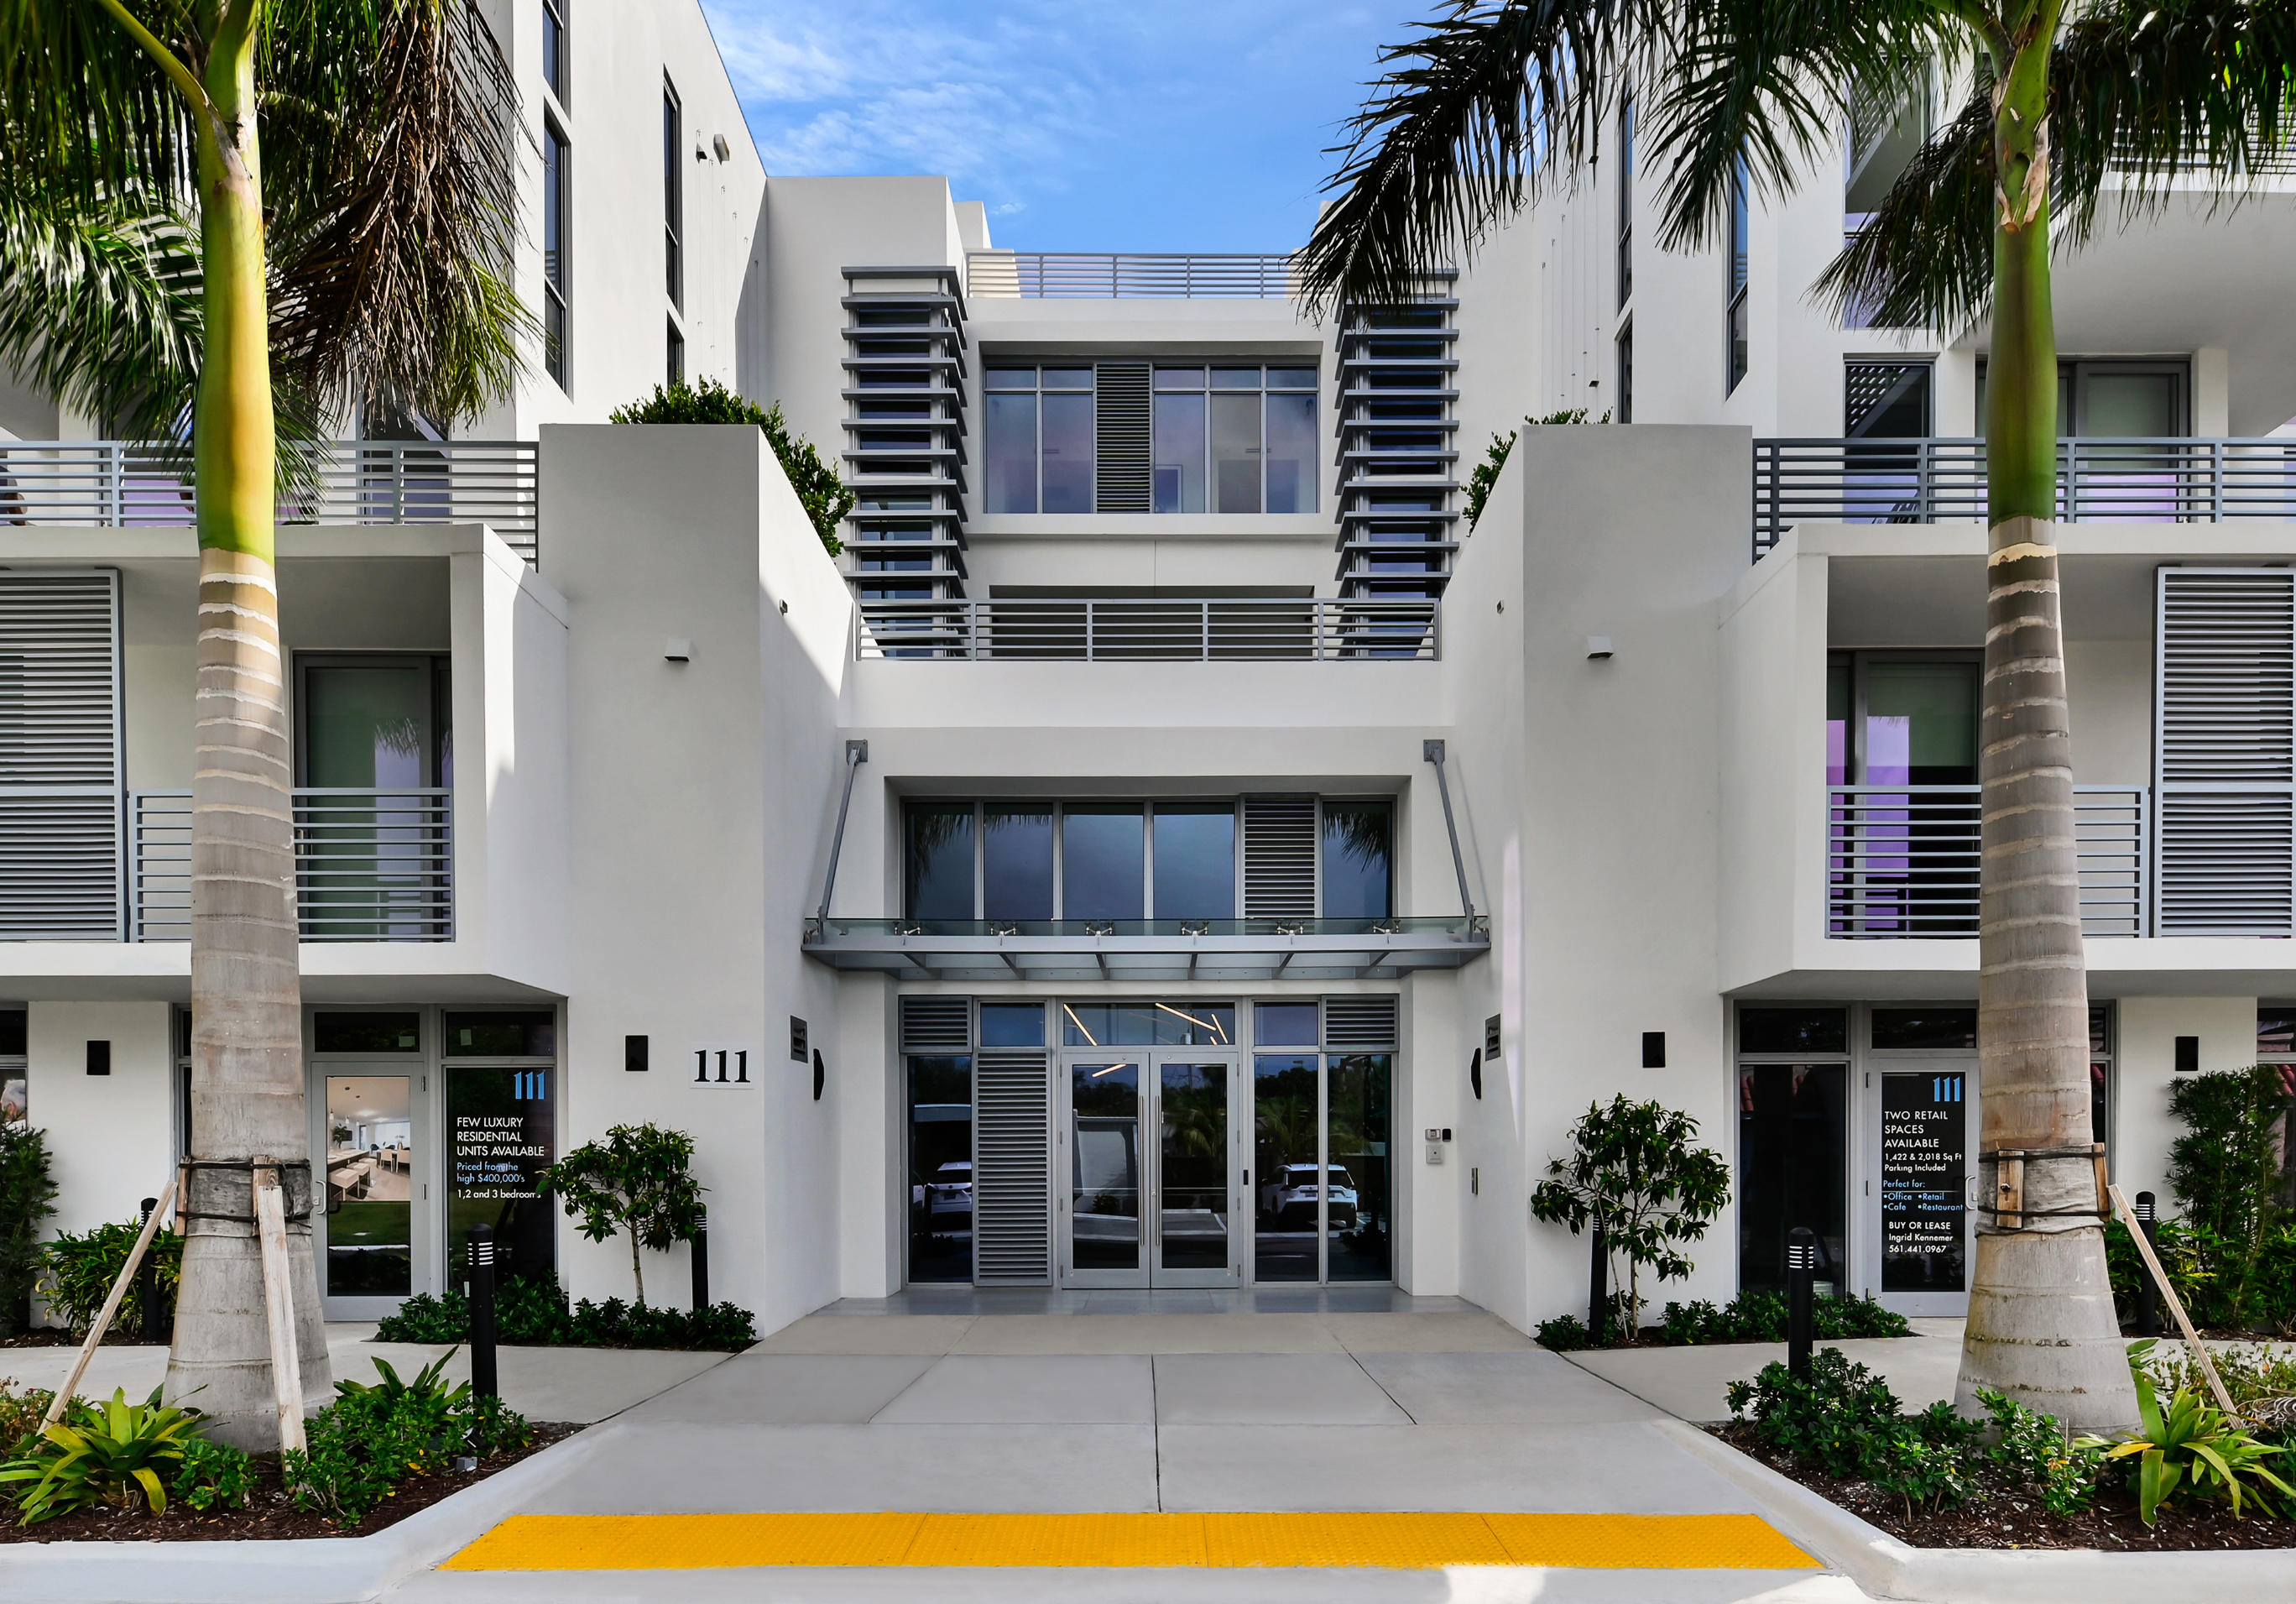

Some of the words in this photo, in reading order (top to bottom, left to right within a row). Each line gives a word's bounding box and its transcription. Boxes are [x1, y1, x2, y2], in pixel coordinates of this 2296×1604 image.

[695, 1050, 750, 1082] 111
[514, 1072, 544, 1100] 111
[1933, 1077, 1959, 1101] 111
[1885, 1111, 1911, 1120] TWO
[1915, 1111, 1949, 1120] RETAIL
[457, 1117, 481, 1126] FEW
[484, 1118, 524, 1127] LUXURY
[1885, 1125, 1924, 1134] SPACES
[457, 1131, 523, 1142] RESIDENTIAL
[1885, 1139, 1939, 1147] AVAILABLE
[457, 1146, 488, 1156] UNITS
[491, 1147, 545, 1156] AVAILABLE
[1944, 1153, 1953, 1162] Sq
[457, 1162, 483, 1170] Priced
[484, 1161, 504, 1171] from
[1885, 1163, 1913, 1173] Parking
[457, 1173, 475, 1184] high
[478, 1173, 525, 1183] $400,000's
[1912, 1179, 1925, 1188] for:
[458, 1189, 472, 1199] 1,2
[473, 1189, 490, 1198] and
[493, 1189, 498, 1198] 3
[1923, 1203, 1964, 1211] Restaurant
[1889, 1233, 1912, 1242] Ingrid
